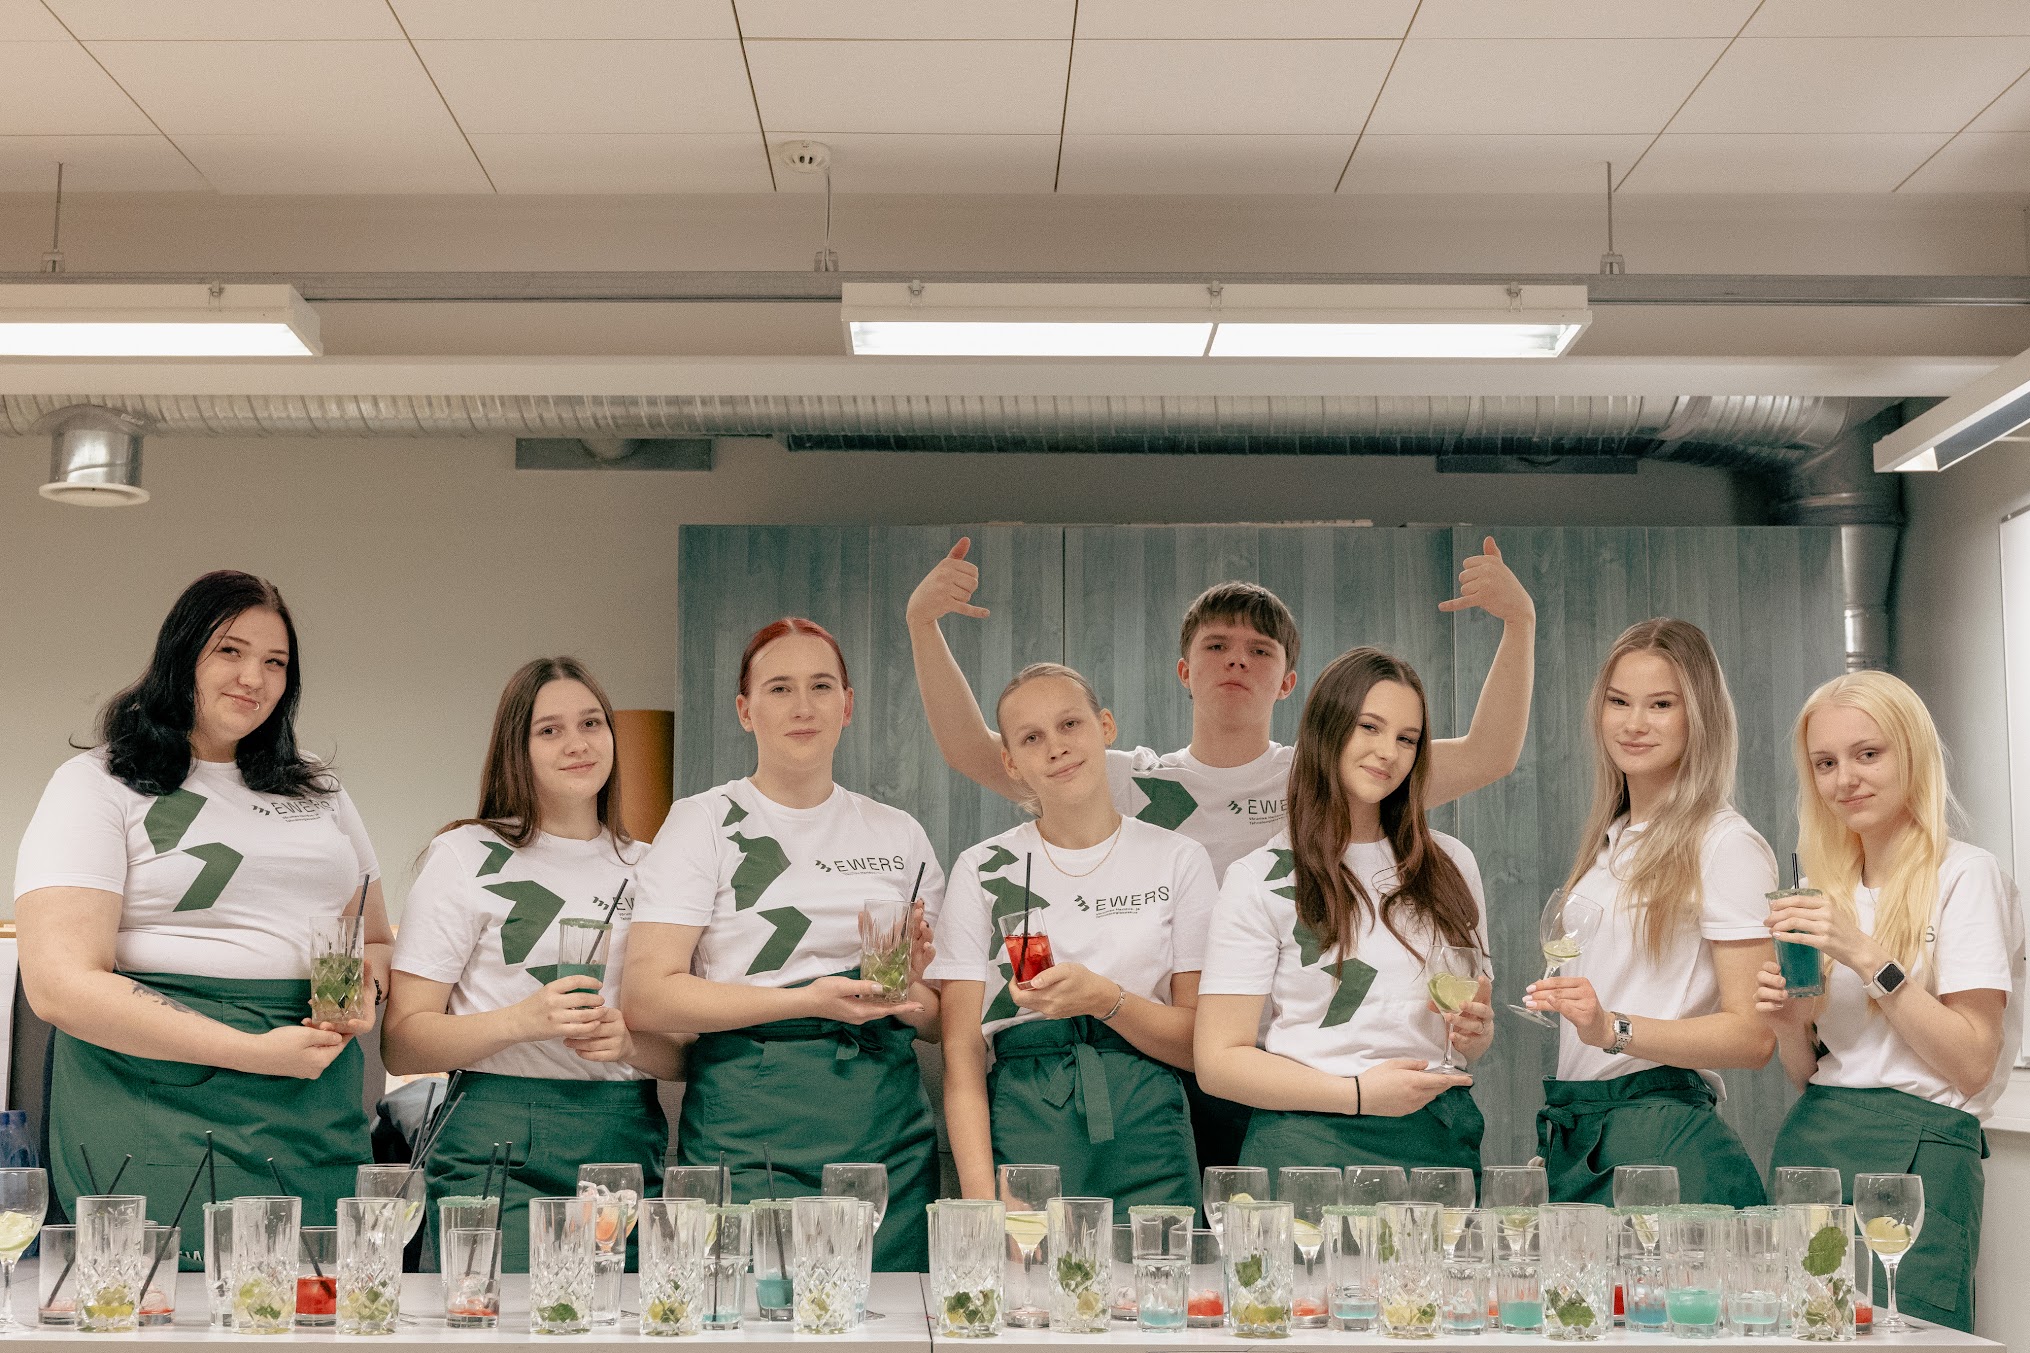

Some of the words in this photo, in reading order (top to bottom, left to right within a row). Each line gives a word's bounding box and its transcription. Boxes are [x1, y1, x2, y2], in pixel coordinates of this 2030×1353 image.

[1248, 799, 1288, 814] EWE
[833, 855, 905, 872] EWERS
[1096, 886, 1170, 911] EWERS
